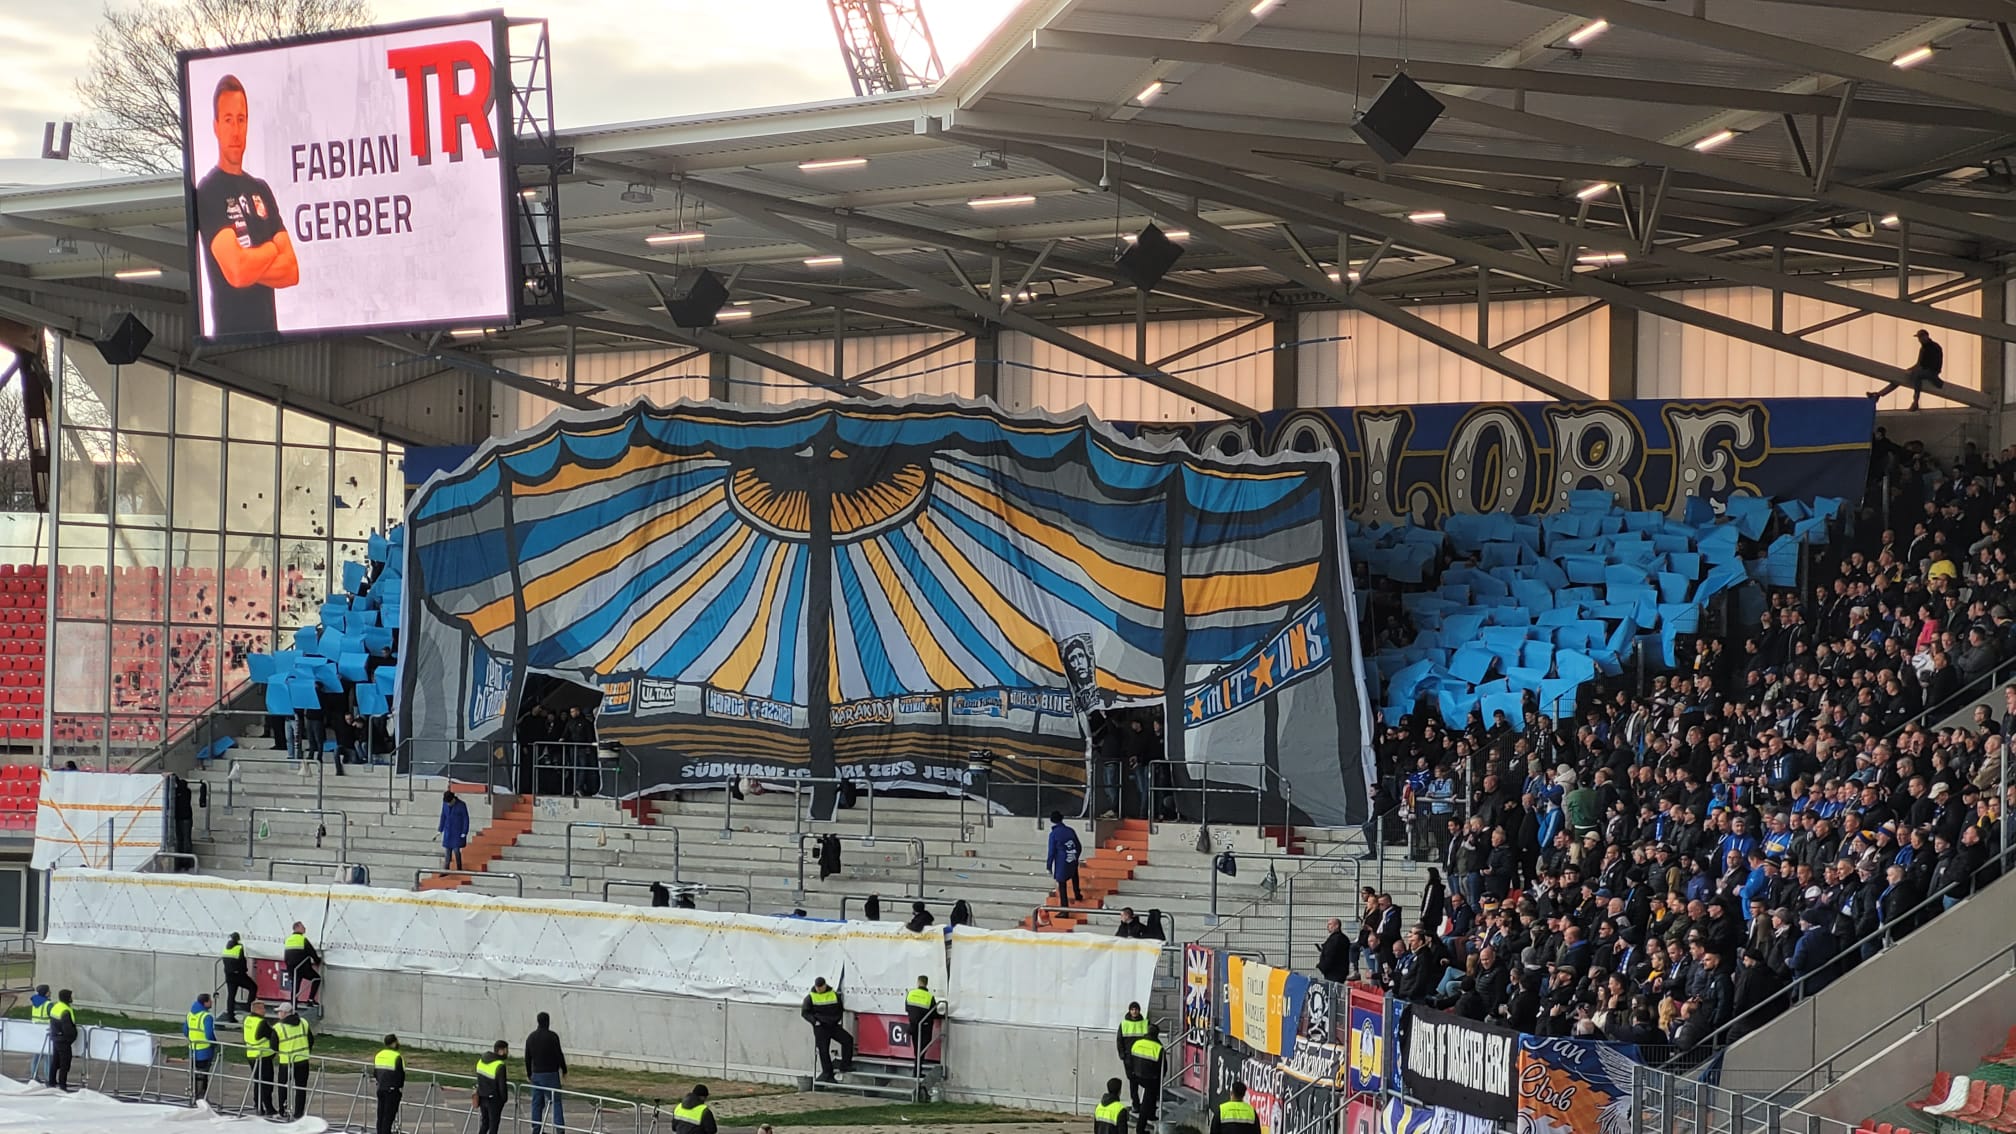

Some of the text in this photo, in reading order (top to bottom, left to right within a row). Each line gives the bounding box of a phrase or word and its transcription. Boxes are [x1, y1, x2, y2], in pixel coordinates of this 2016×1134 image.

[387, 40, 499, 164] TR
[290, 134, 400, 183] FABIAN
[294, 194, 413, 243] GERBER
[1206, 611, 1324, 715] MIT UNS
[641, 685, 677, 701] ULTRAS
[1436, 1024, 1447, 1081] OF
[1447, 1024, 1484, 1091] DISASTER
[1484, 1033, 1512, 1098] GERA
[1519, 1063, 1577, 1112] Club
